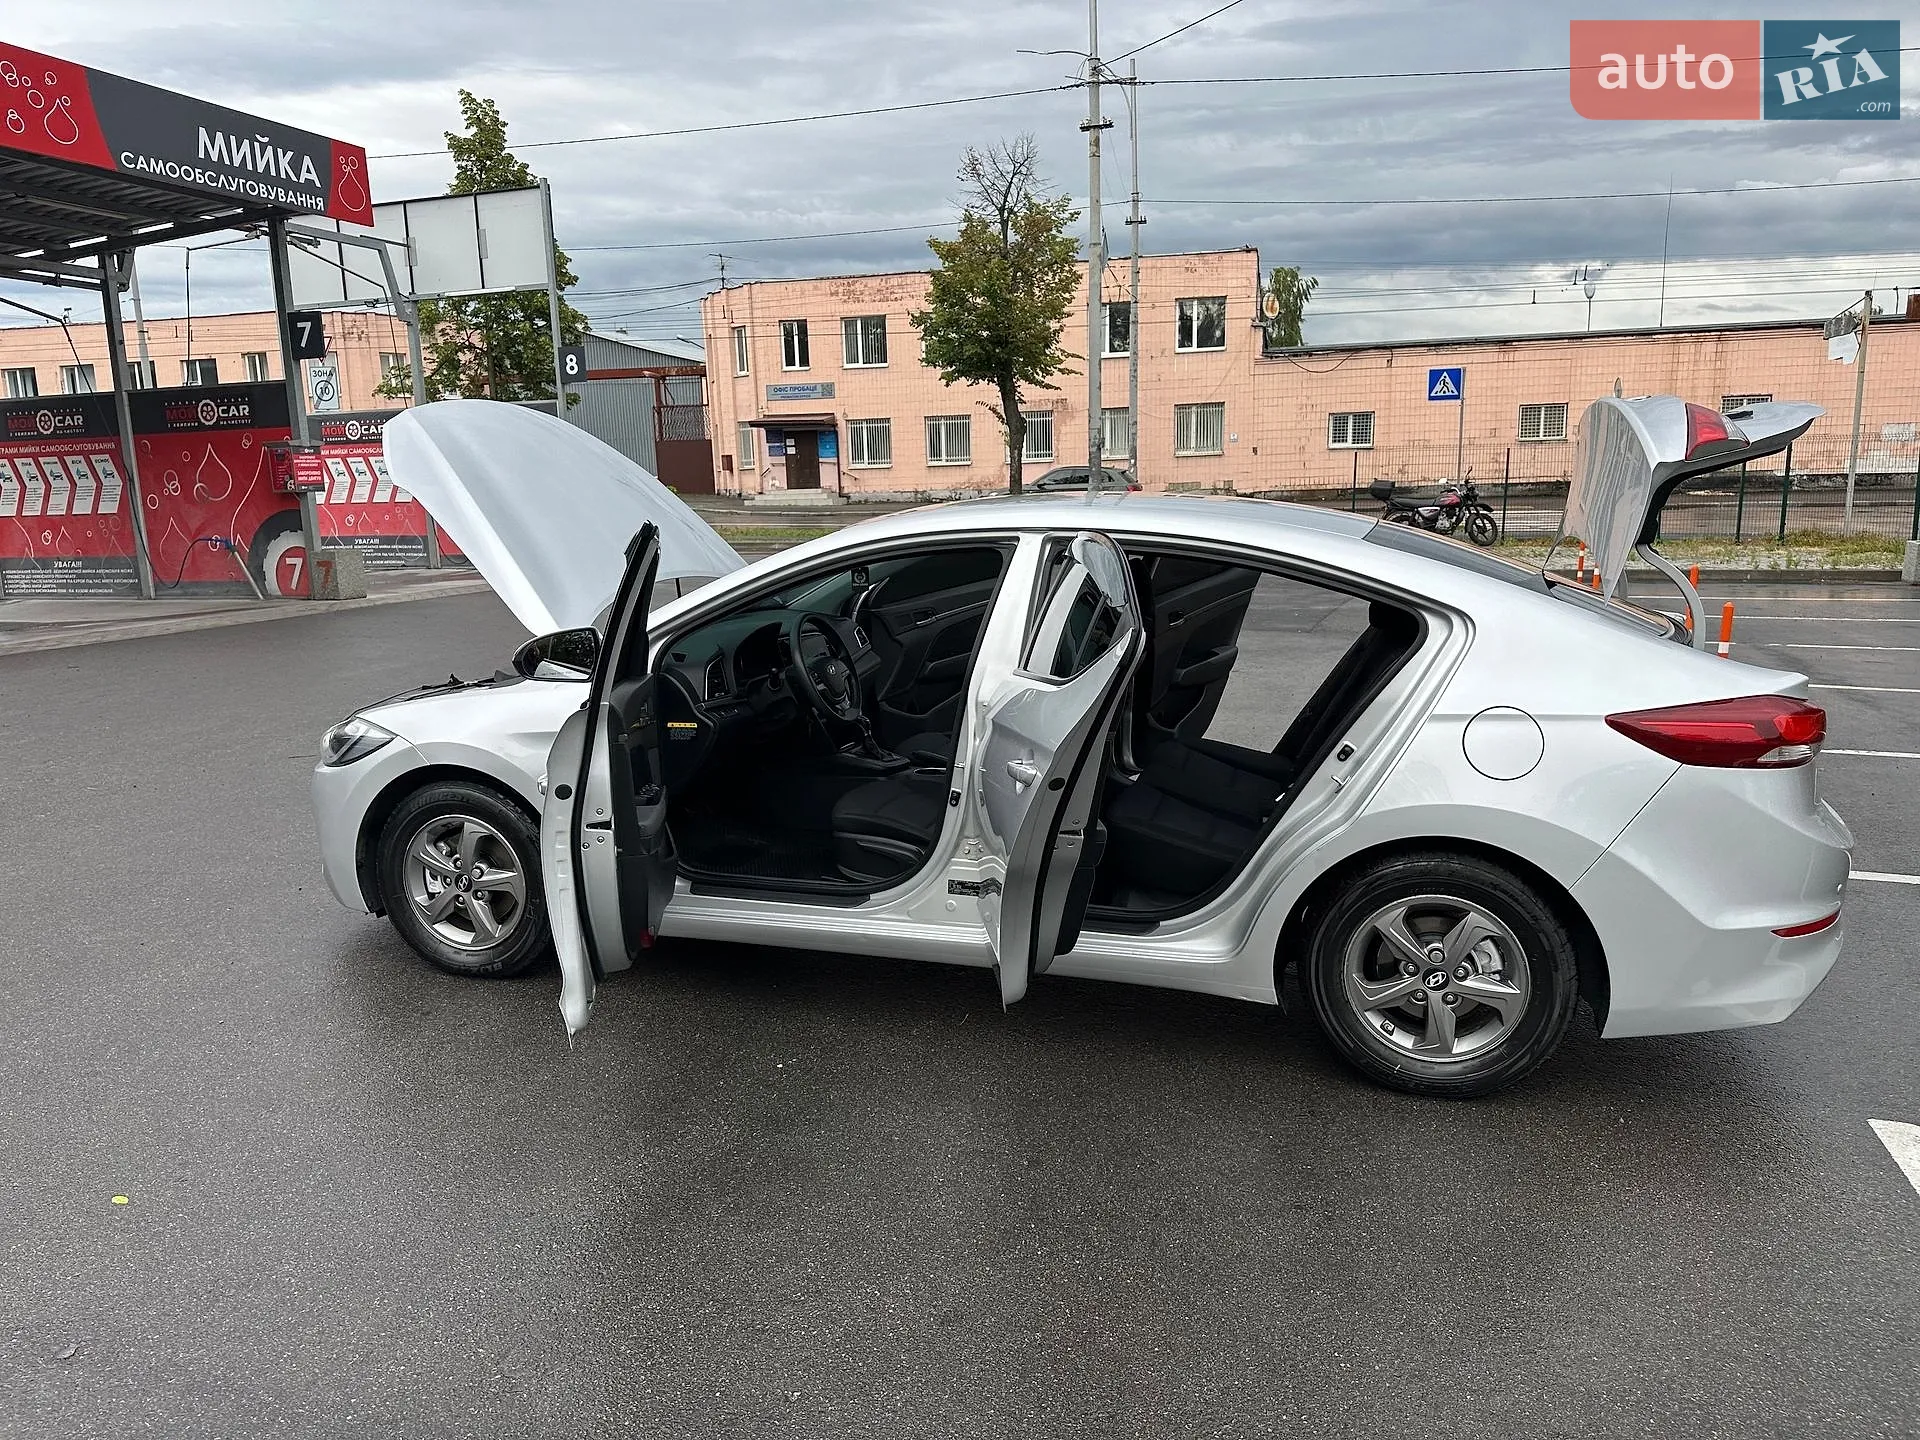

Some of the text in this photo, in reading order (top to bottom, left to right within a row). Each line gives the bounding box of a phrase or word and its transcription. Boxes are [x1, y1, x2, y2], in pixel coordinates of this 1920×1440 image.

[198, 126, 322, 188] МИЙКА
[120, 151, 325, 211] САМООБСЛУГОВУВАННЯ
[296, 321, 313, 349] 7
[565, 354, 579, 375] 8
[312, 369, 334, 378] ЗОНА
[319, 386, 331, 396] 10
[219, 405, 250, 417] CAR
[55, 415, 84, 427] CAR
[321, 425, 346, 437] МОЙ
[19, 444, 40, 454] МИЙКИ
[40, 441, 116, 454] САМООБСЛУГОВУВАННЯ
[54, 560, 83, 569] УВАГА!!!
[285, 557, 303, 591] 7
